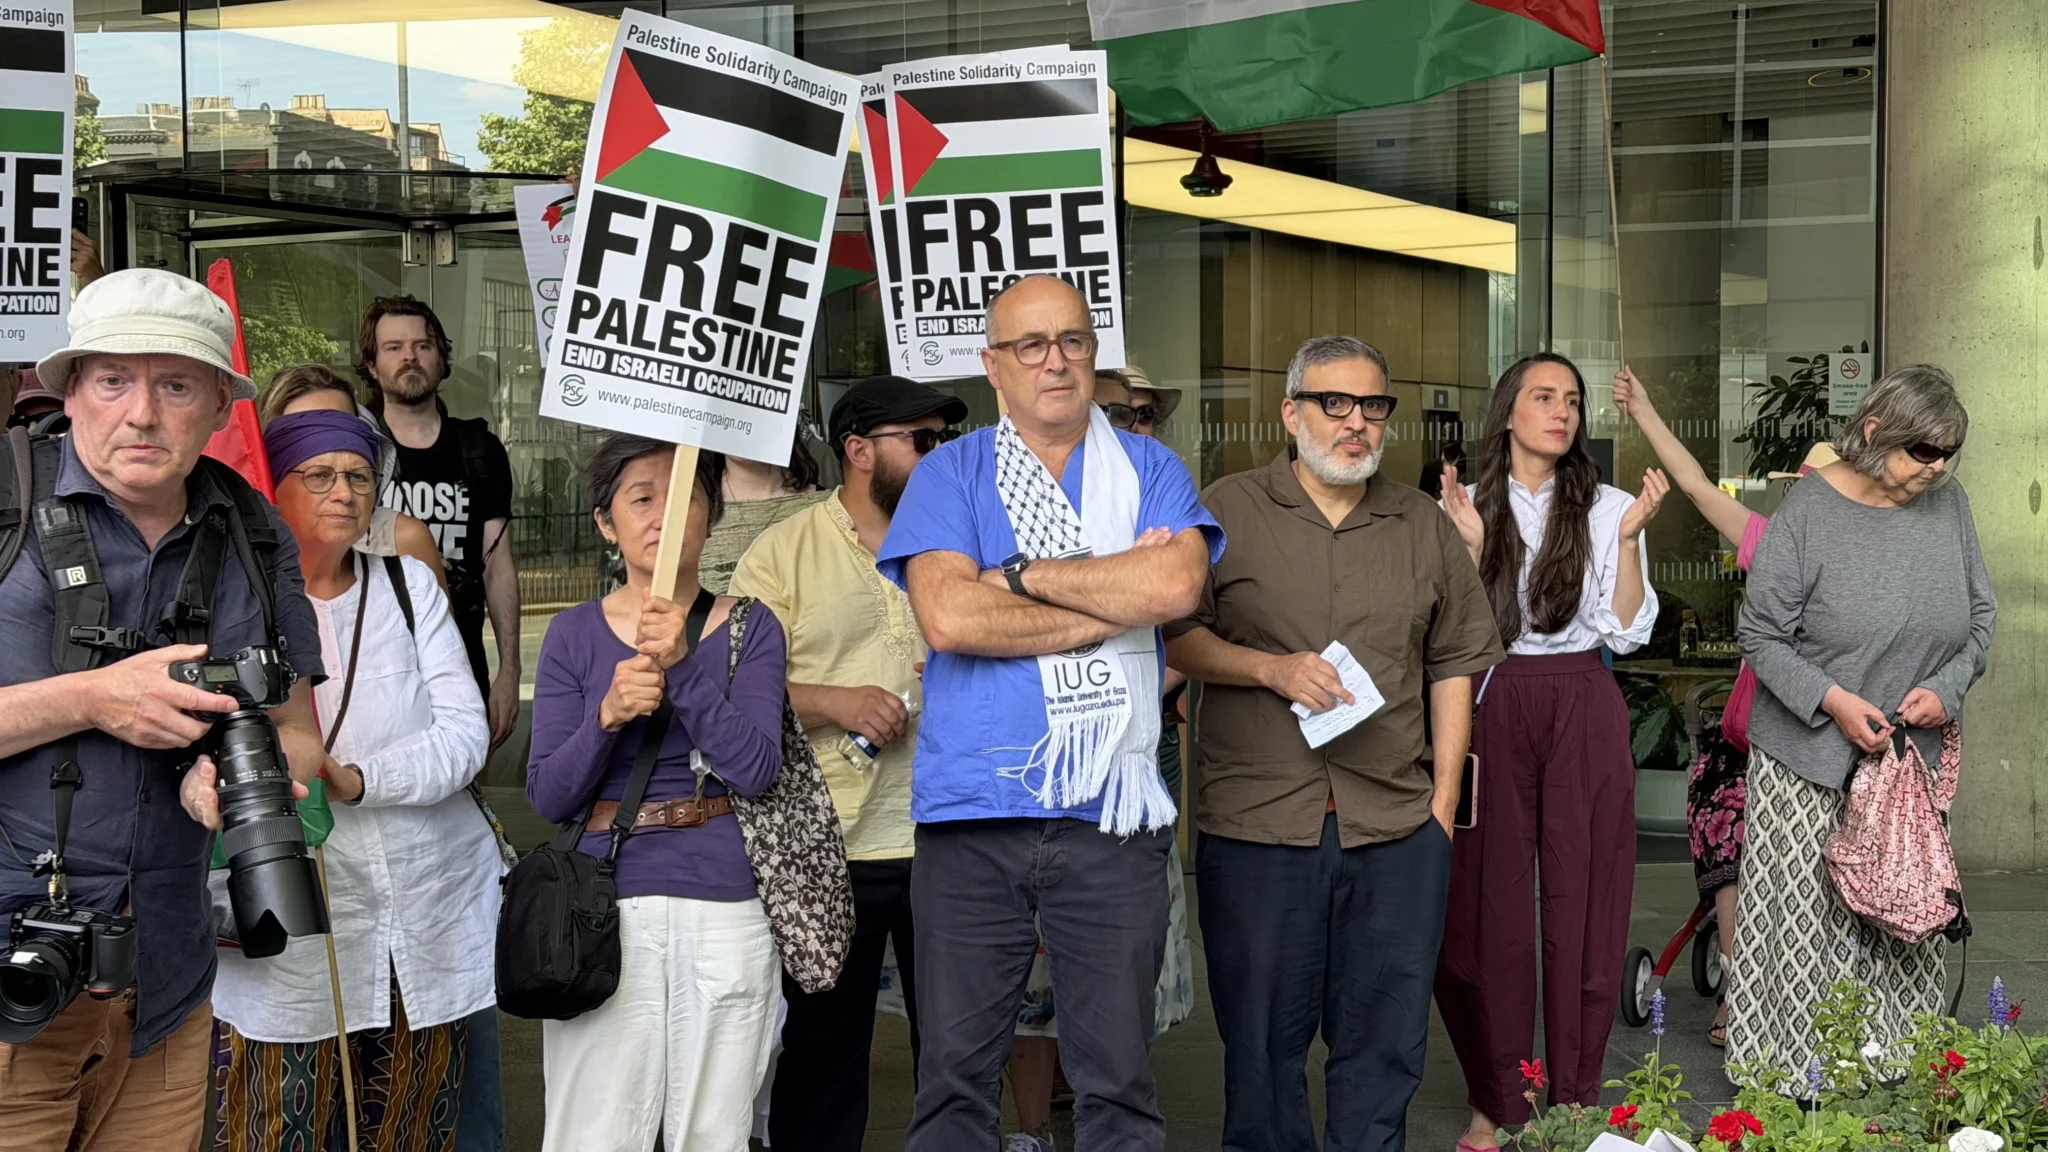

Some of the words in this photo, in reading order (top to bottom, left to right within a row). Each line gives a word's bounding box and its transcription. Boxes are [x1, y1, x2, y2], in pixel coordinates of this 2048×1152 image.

[0, 5, 64, 27] ampaign
[626, 24, 701, 59] Palestine
[705, 46, 781, 84] Solidarity
[783, 69, 848, 106] Campaign
[893, 66, 956, 86] Palestine
[959, 63, 1022, 81] Solidarity
[1026, 61, 1096, 77] Campaign
[905, 190, 1109, 275] FREE
[576, 189, 817, 338] FREE
[566, 290, 799, 384] PALESTINE
[917, 318, 950, 335] END
[564, 344, 606, 370] END
[611, 354, 690, 388] ISRAELI
[694, 371, 790, 412] OCCUPATION
[598, 389, 753, 435] www.palestinecampaign.org
[1045, 696, 1055, 705] The
[1057, 694, 1075, 704] Islamic
[1077, 690, 1102, 701] University
[1105, 688, 1111, 697] of
[1113, 686, 1127, 695] Gaza
[1054, 659, 1112, 693] IUG
